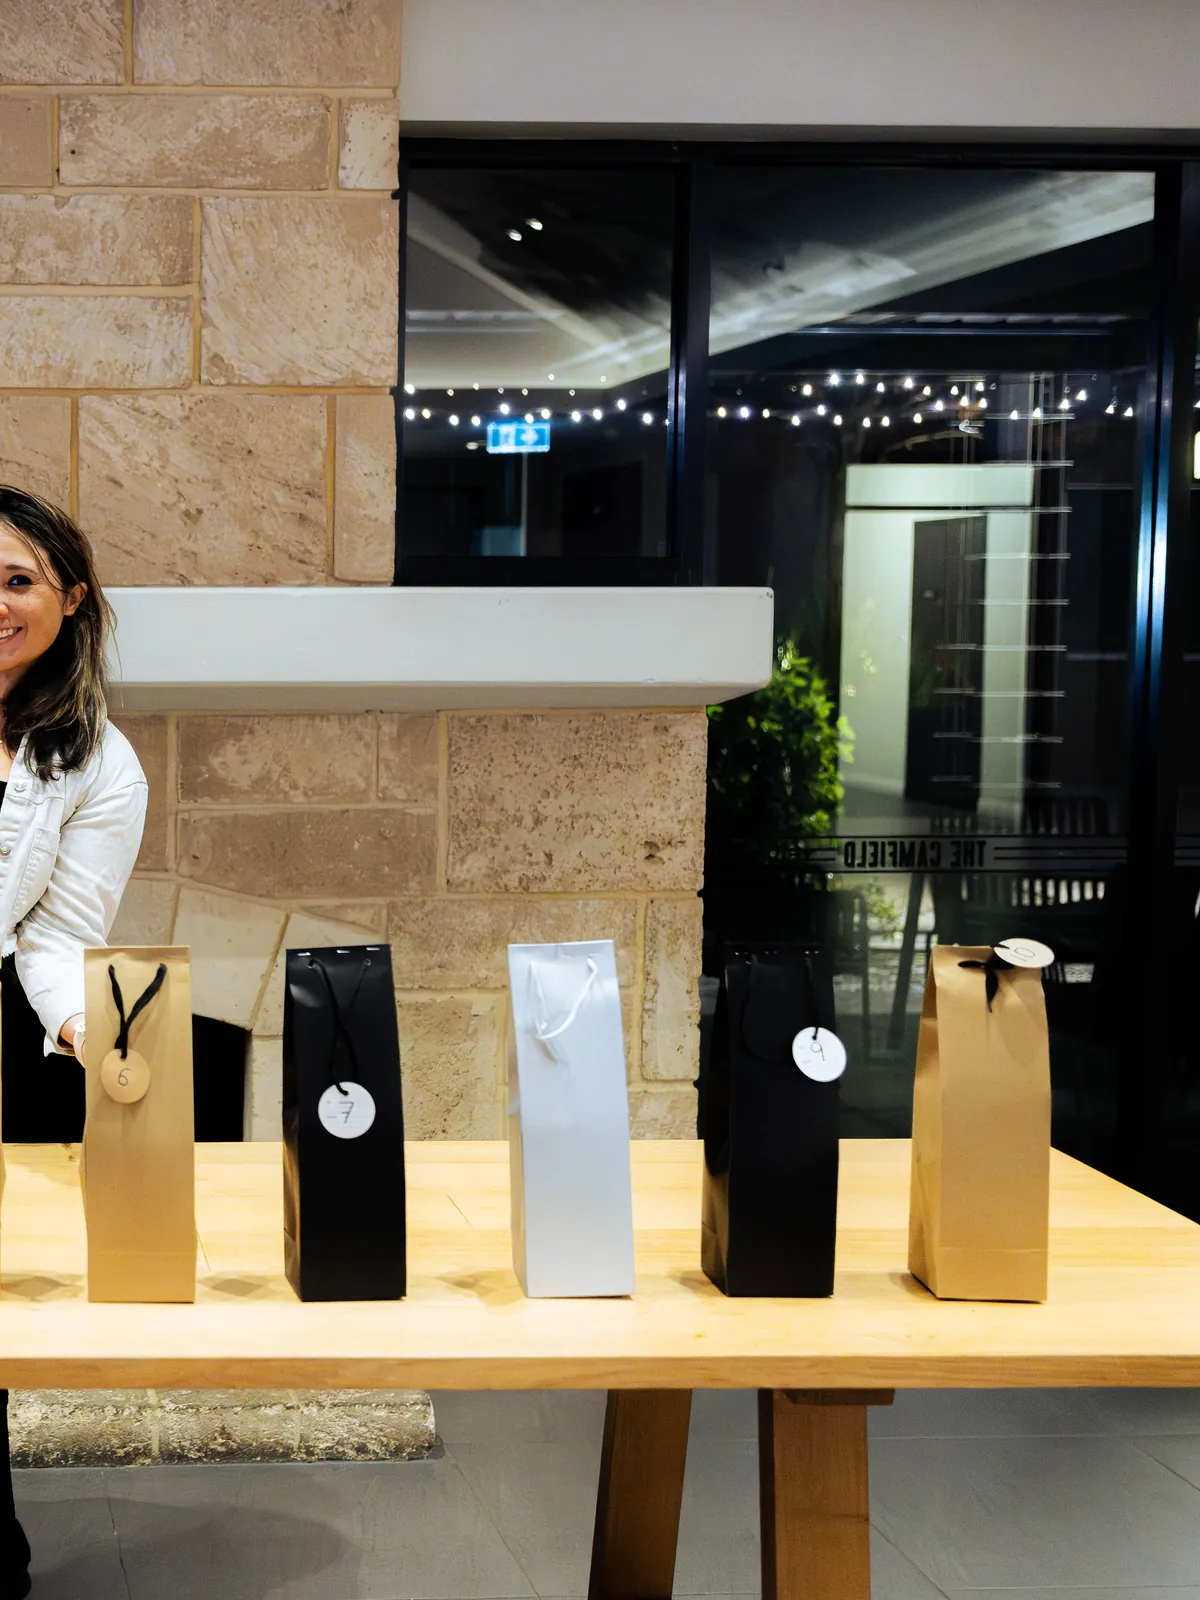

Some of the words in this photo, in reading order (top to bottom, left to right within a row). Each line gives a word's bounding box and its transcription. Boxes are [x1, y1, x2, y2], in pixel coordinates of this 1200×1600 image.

[810, 1041, 825, 1062] 9
[118, 1067, 133, 1087] 6
[339, 1101, 355, 1125] 7
